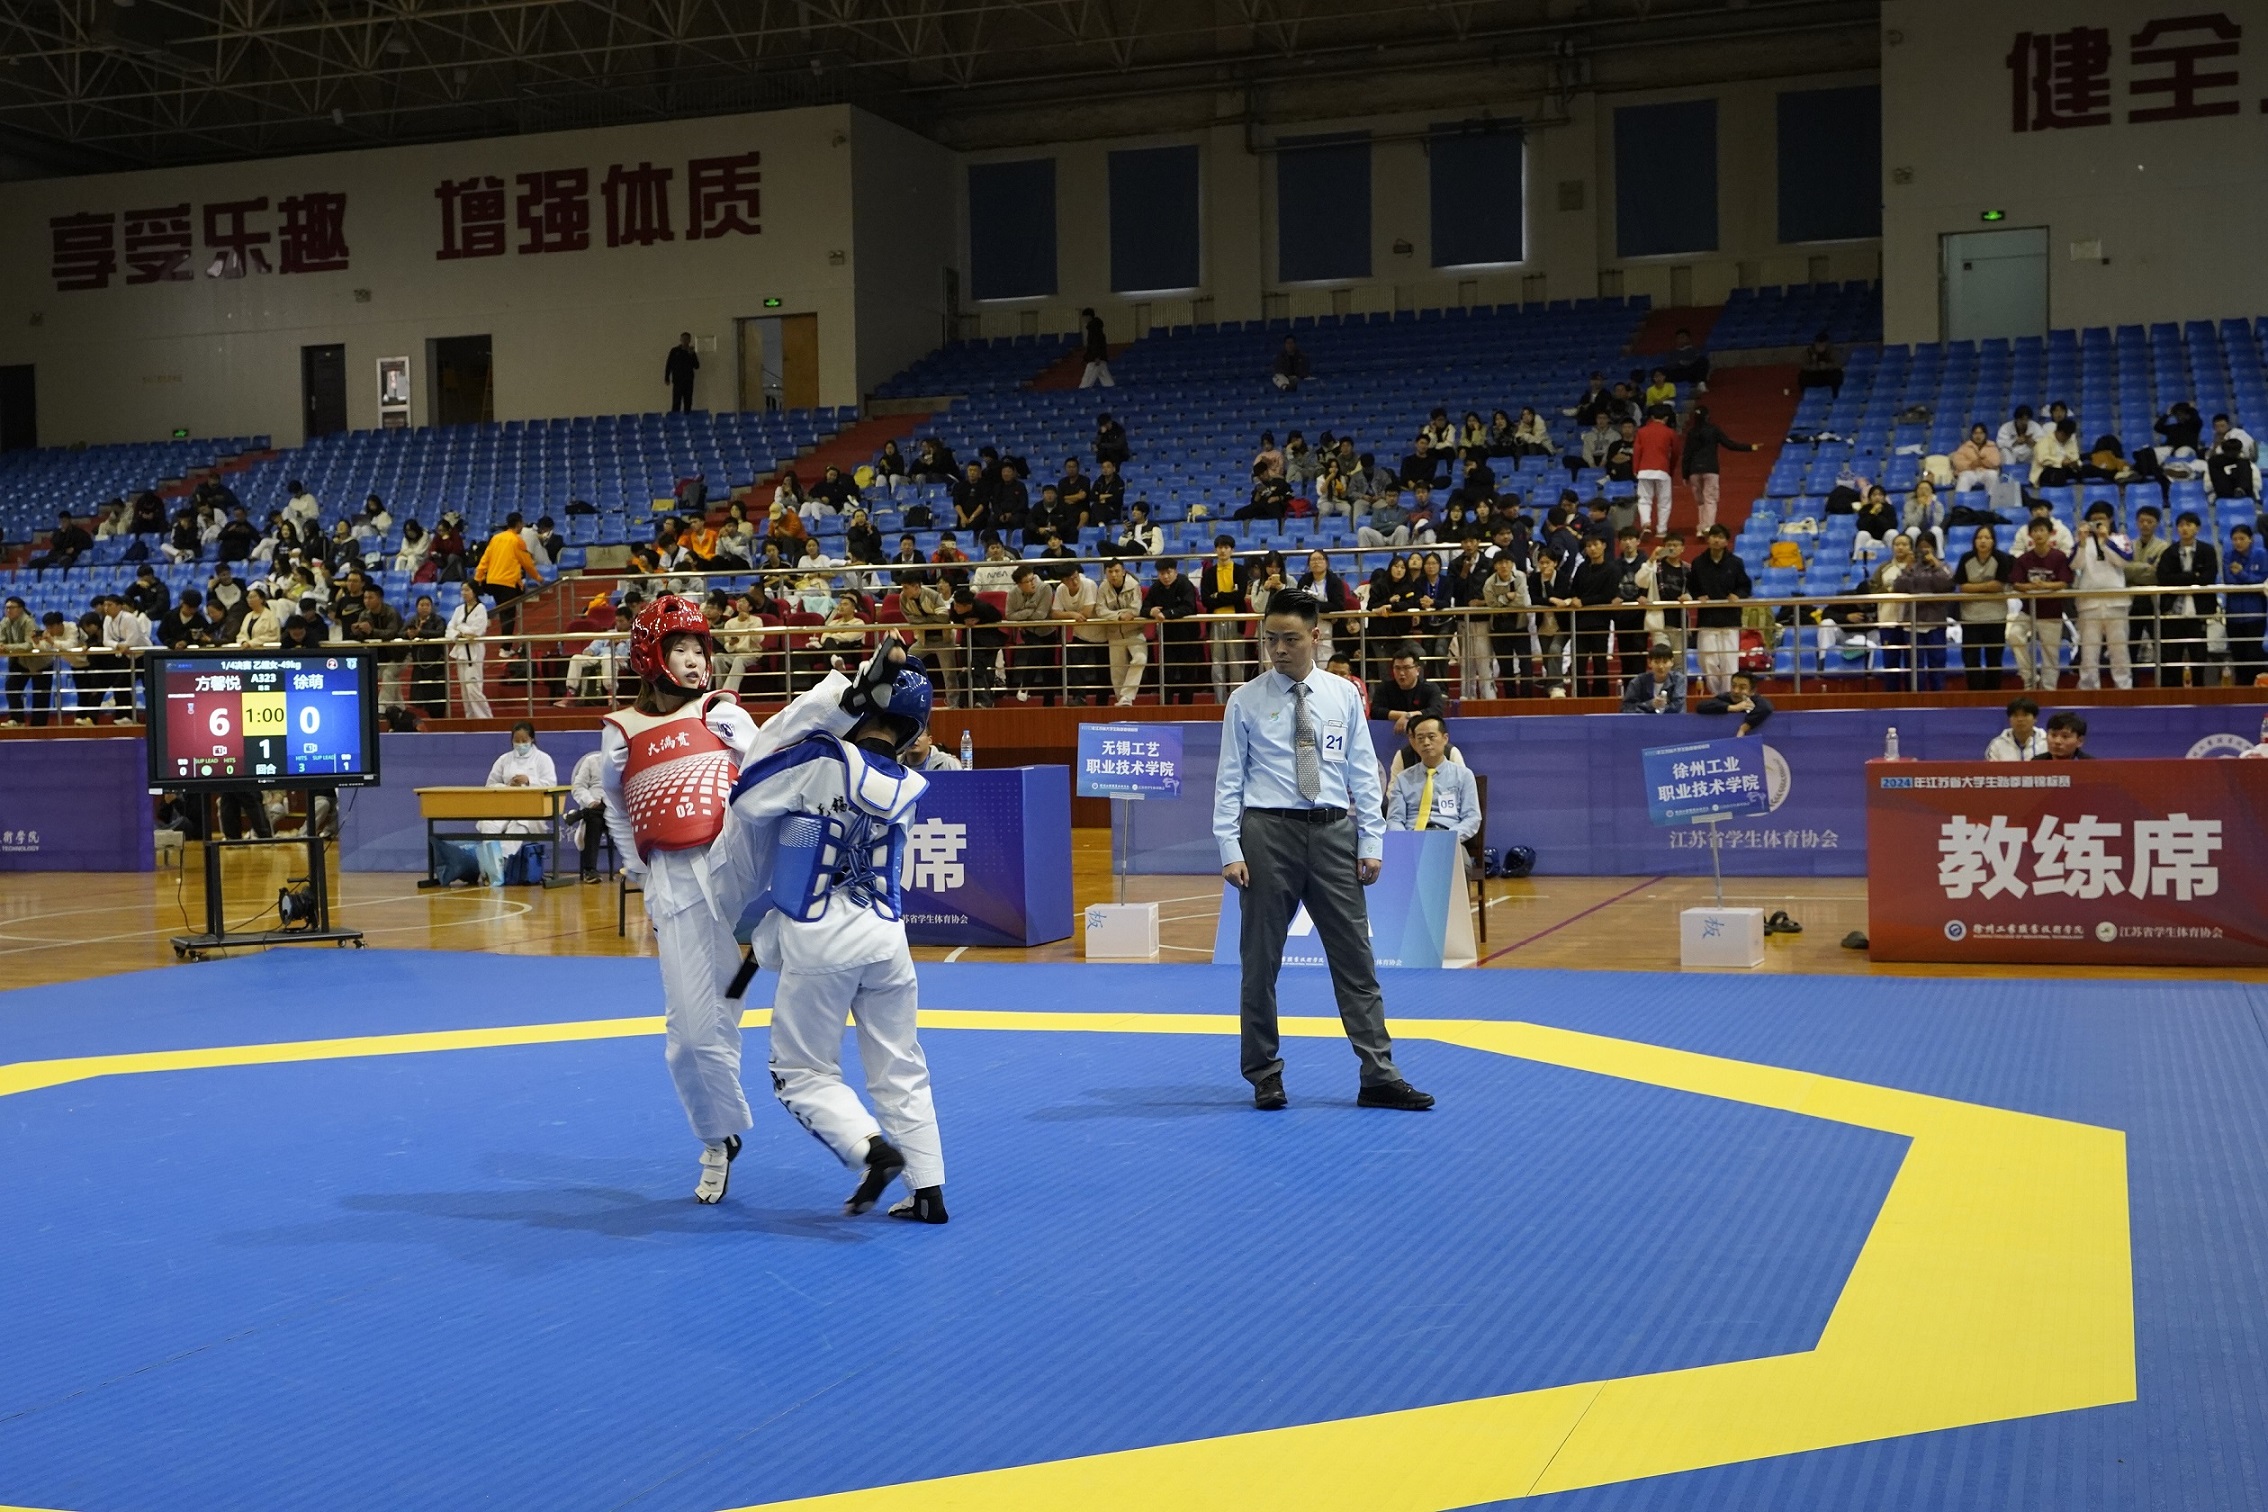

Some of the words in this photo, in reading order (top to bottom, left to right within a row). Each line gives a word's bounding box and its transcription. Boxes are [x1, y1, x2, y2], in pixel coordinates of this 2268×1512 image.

[2006, 12, 2268, 132] 健全
[51, 192, 349, 291] 享受乐趣
[435, 151, 762, 260] 增强体质
[195, 675, 241, 691] 方馨悦
[251, 674, 276, 682] A323
[293, 674, 324, 690] 徐萌
[209, 708, 230, 736] 6
[246, 707, 284, 723] 1:00
[300, 706, 320, 734] 0
[259, 739, 270, 759] 1
[1101, 740, 1160, 757] 无锡工艺
[1325, 734, 1343, 751] 21
[226, 764, 234, 775] 0
[256, 763, 277, 775] 回合
[298, 763, 306, 772] 3
[343, 761, 349, 771] 1
[1086, 758, 1175, 777] 职业技术学院
[1672, 756, 1741, 780] 徐州工业
[1657, 774, 1760, 802] 职业技术学院
[676, 802, 696, 818] 02
[1440, 799, 1454, 809] 05
[1669, 829, 1839, 849] 江苏省学生体育协会
[900, 817, 967, 893] 席
[1938, 813, 2223, 901] 教练席
[2119, 926, 2223, 938] 江苏省学生体育协会
